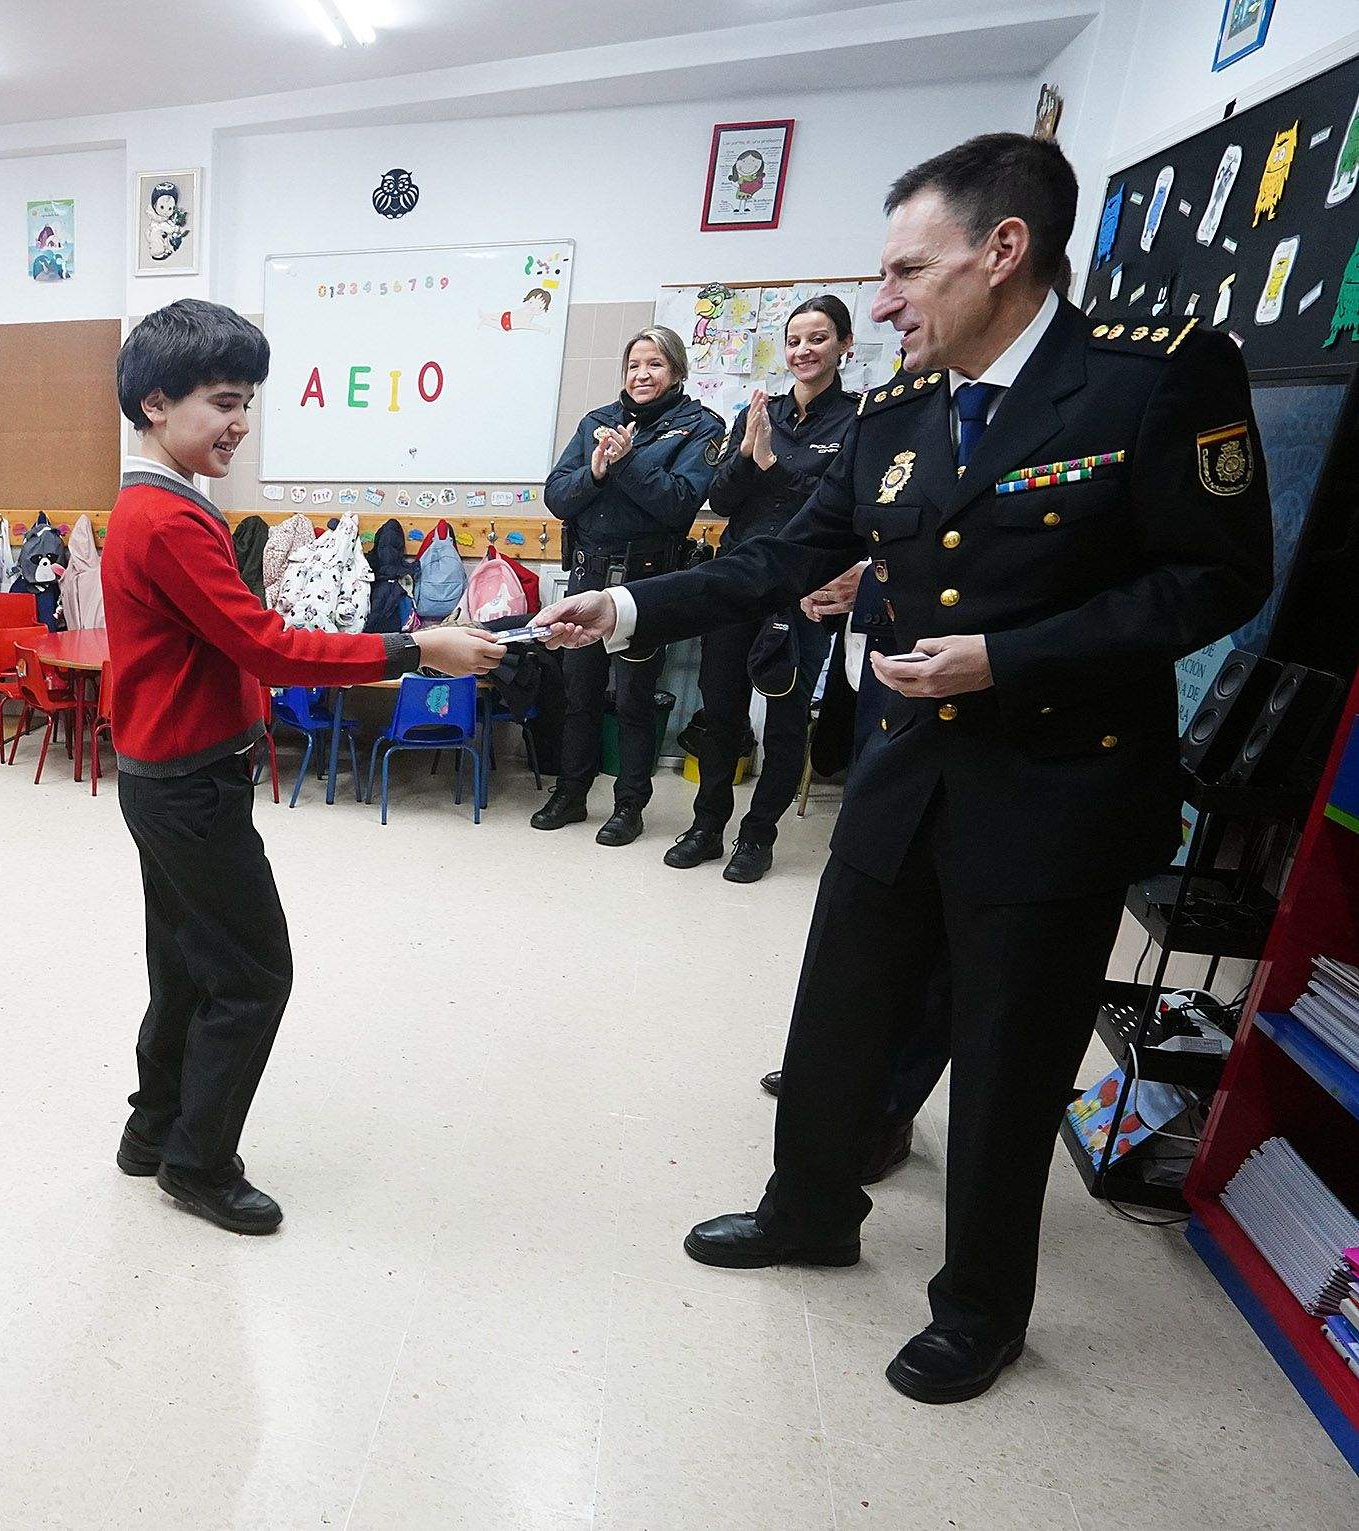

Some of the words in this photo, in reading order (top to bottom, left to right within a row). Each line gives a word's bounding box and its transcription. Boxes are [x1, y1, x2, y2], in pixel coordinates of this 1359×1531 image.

[300, 367, 325, 408] A
[348, 366, 371, 408] E
[388, 369, 402, 412] I
[418, 361, 444, 402] O
